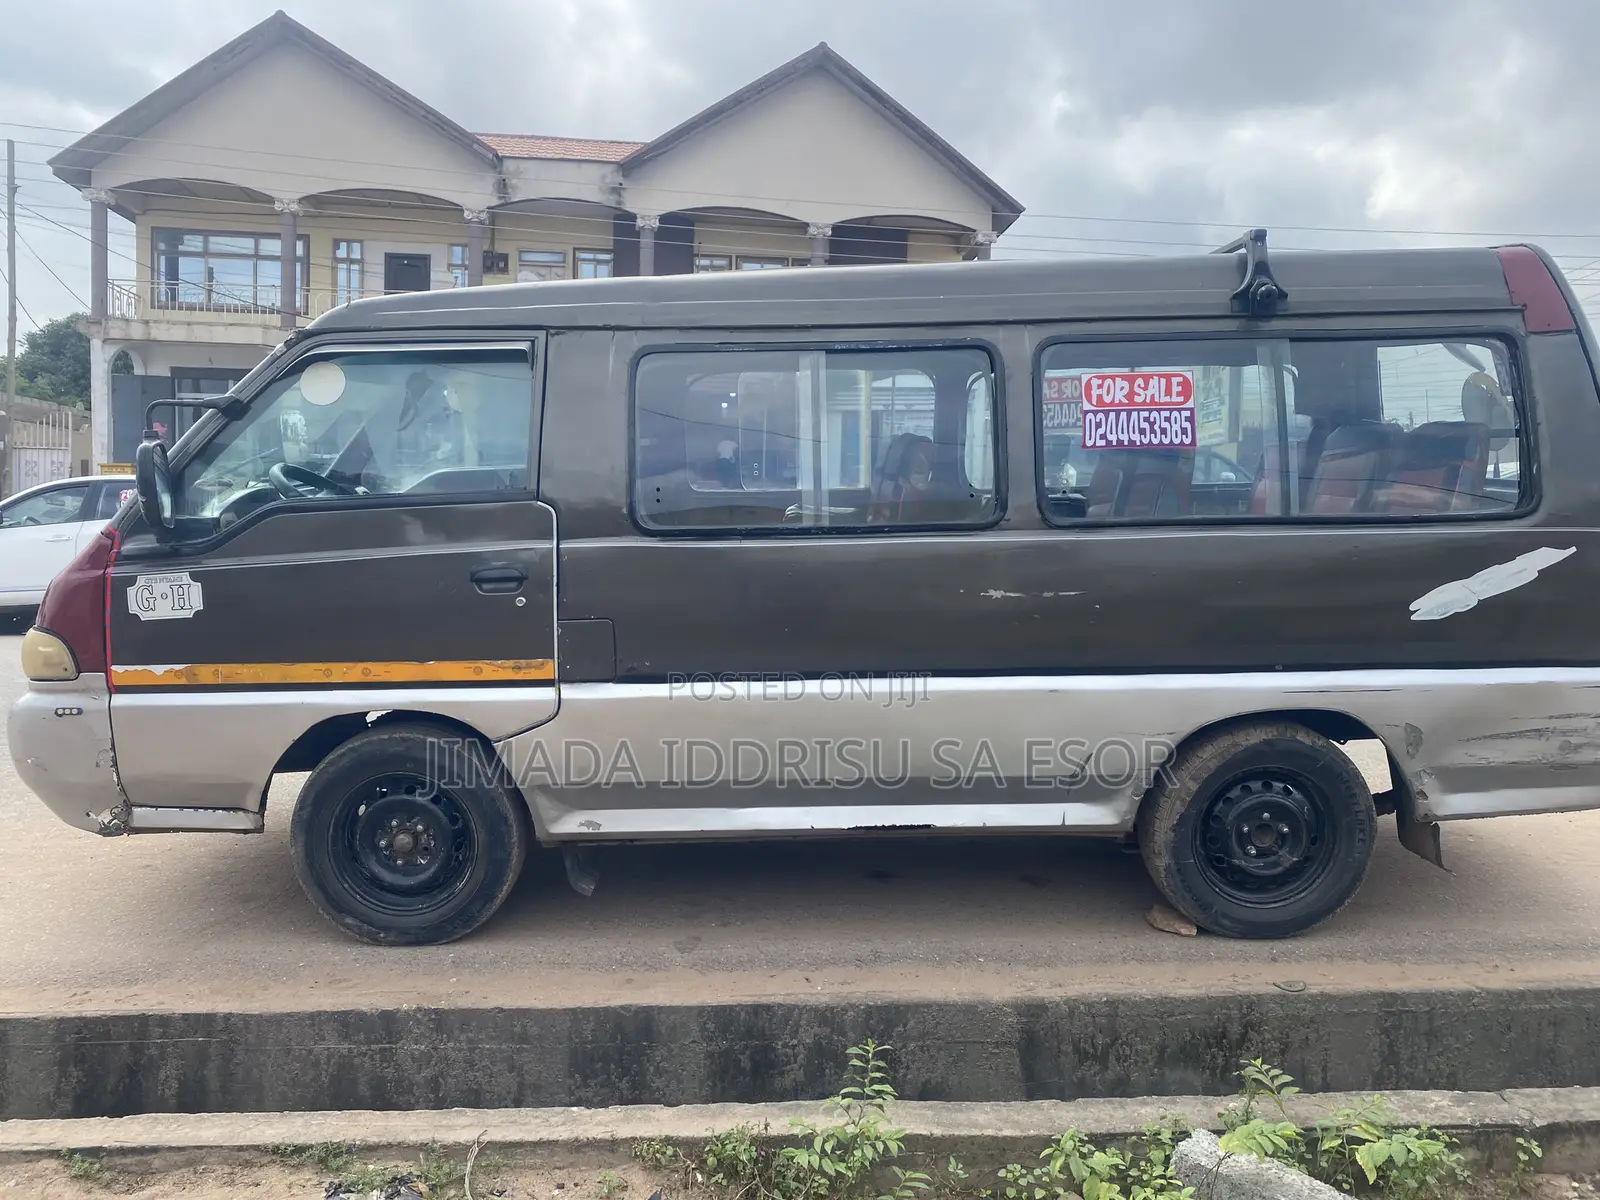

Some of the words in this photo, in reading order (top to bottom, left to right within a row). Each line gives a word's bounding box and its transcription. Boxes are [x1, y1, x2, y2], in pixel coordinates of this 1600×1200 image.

[1091, 376, 1130, 405] FOR
[1133, 375, 1184, 404] SALE
[1085, 410, 1192, 447] 0244453585
